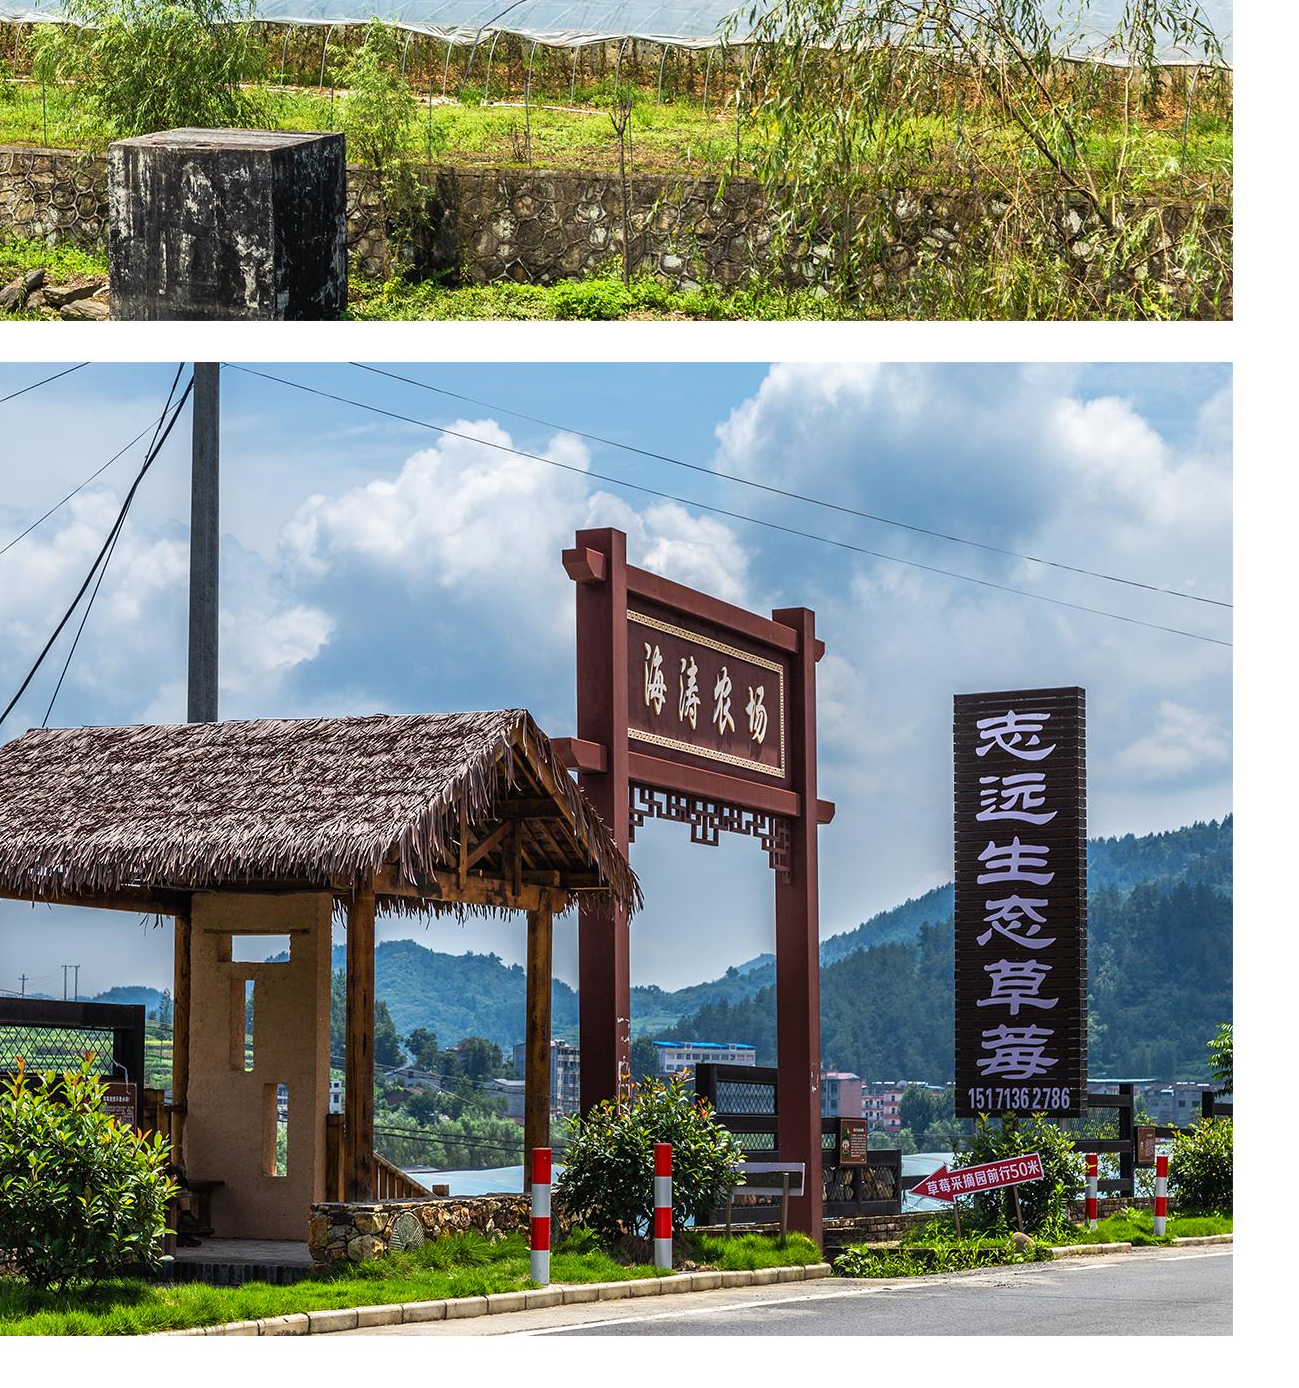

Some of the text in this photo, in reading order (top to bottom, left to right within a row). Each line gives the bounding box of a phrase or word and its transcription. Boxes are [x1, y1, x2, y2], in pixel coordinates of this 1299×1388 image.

[643, 642, 768, 744] 海涛农场
[976, 710, 1059, 1080] 志远生态草莓
[926, 1160, 1040, 1196] 草莓采摘园前行50米
